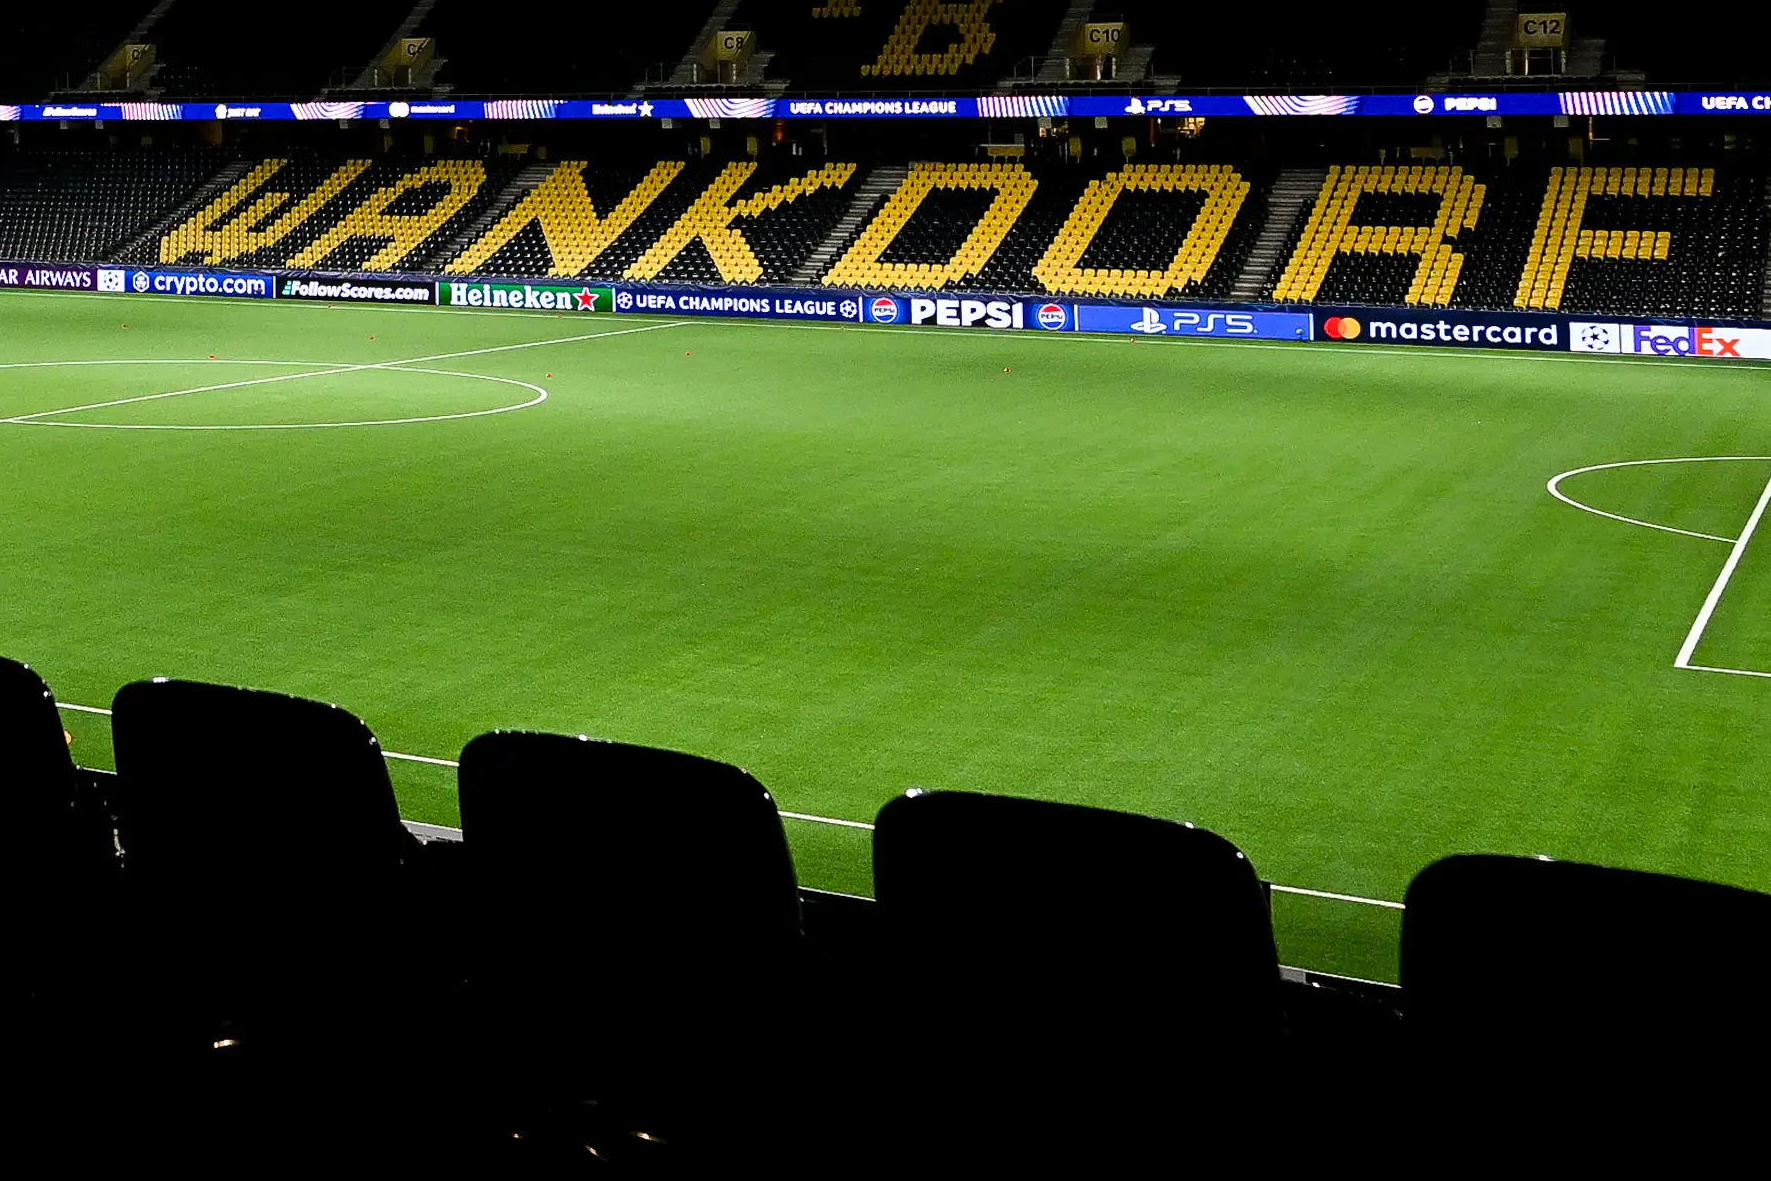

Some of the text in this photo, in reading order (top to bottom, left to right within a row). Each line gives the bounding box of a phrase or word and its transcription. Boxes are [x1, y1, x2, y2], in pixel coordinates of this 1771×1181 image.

[1089, 28, 1121, 43] C10
[1523, 20, 1561, 35] C12
[724, 36, 744, 49] C8
[790, 102, 957, 115] UEFA CHAMPIONS LEAGUE
[1147, 100, 1193, 113] PS5
[1444, 97, 1497, 111] PEPSI
[1701, 95, 1749, 110] UEFA
[158, 158, 1715, 310] WANKDORF
[25, 269, 91, 287] AIRWAYS
[154, 273, 266, 295] crypto.com
[291, 280, 430, 301] FollowScores.com
[450, 283, 573, 310] Heineken
[636, 294, 836, 316] UEFA CHAMPIONS LEAGUE
[911, 299, 1024, 329] PEPSI
[1173, 312, 1254, 333] PS5
[1369, 319, 1559, 346] mastercard
[1633, 327, 1741, 357] FedEx
